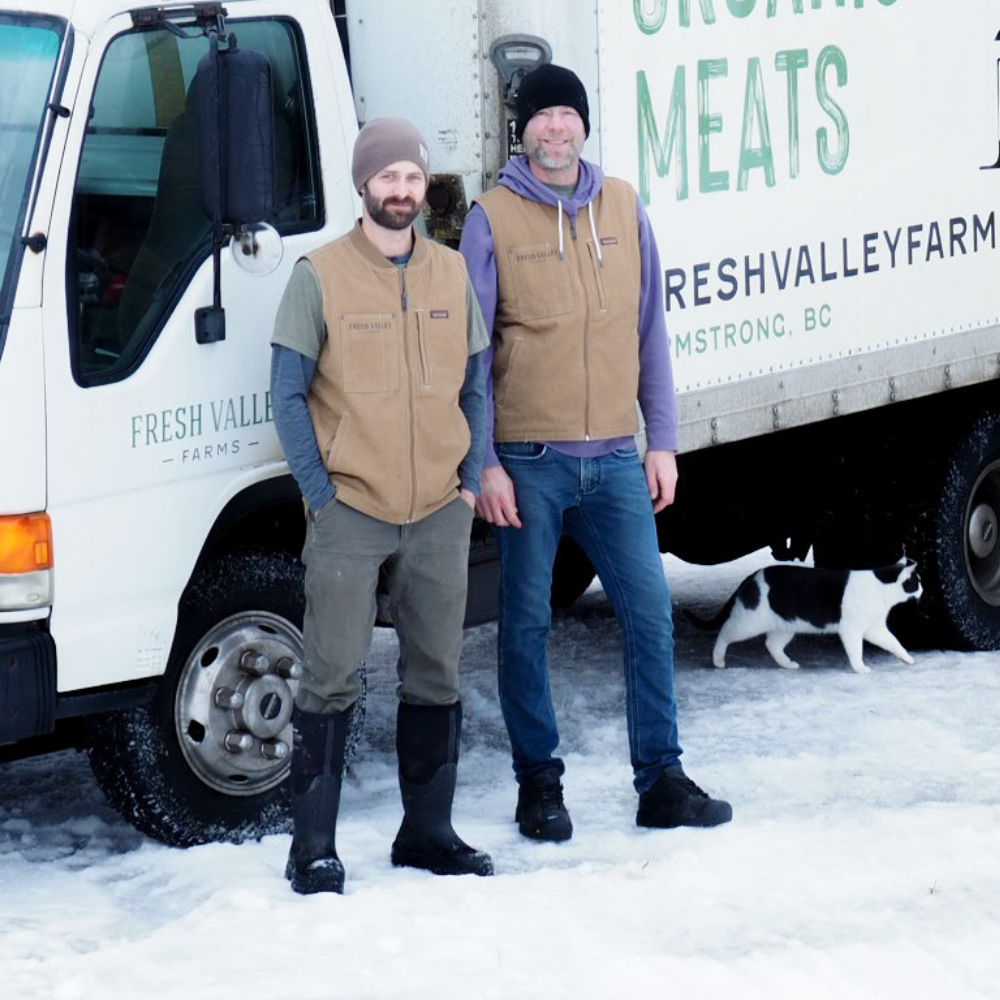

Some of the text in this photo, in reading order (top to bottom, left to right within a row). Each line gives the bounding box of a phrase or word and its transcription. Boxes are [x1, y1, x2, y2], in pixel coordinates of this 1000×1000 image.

[636, 44, 850, 205] MEATS
[669, 304, 832, 358] MSTRONG, BC
[131, 404, 203, 449] FRESH
[182, 440, 240, 464] FARMS
